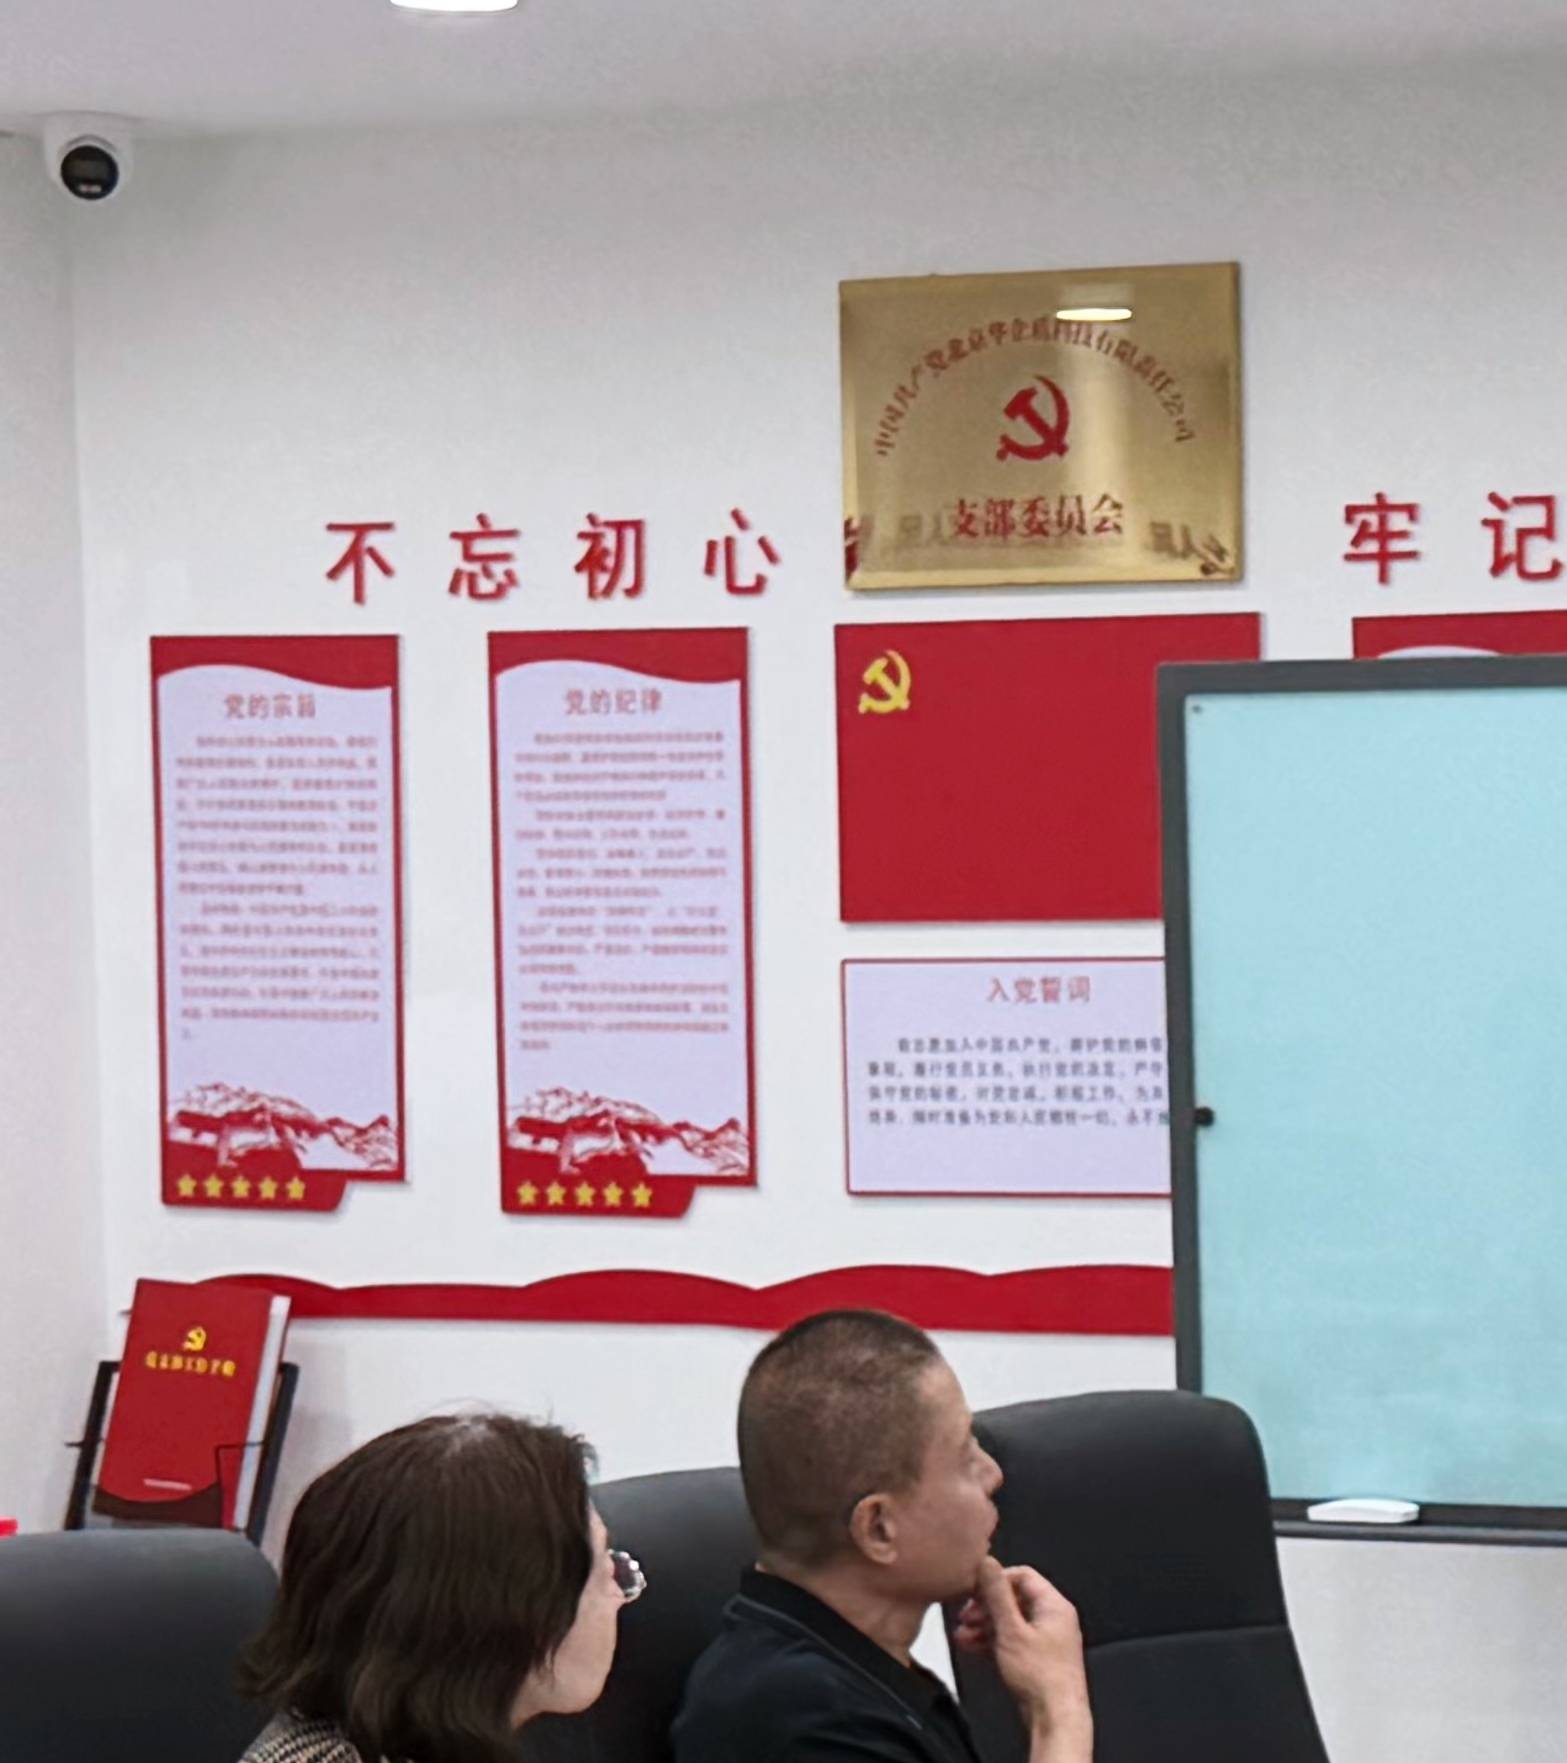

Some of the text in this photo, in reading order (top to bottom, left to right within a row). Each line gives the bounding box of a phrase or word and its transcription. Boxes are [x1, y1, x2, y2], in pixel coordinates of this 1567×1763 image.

[952, 493, 1125, 542] 支部委员会
[325, 507, 780, 605] 不忘初心
[565, 688, 662, 715] 党的纪律
[987, 975, 1091, 1003] 入党誓词
